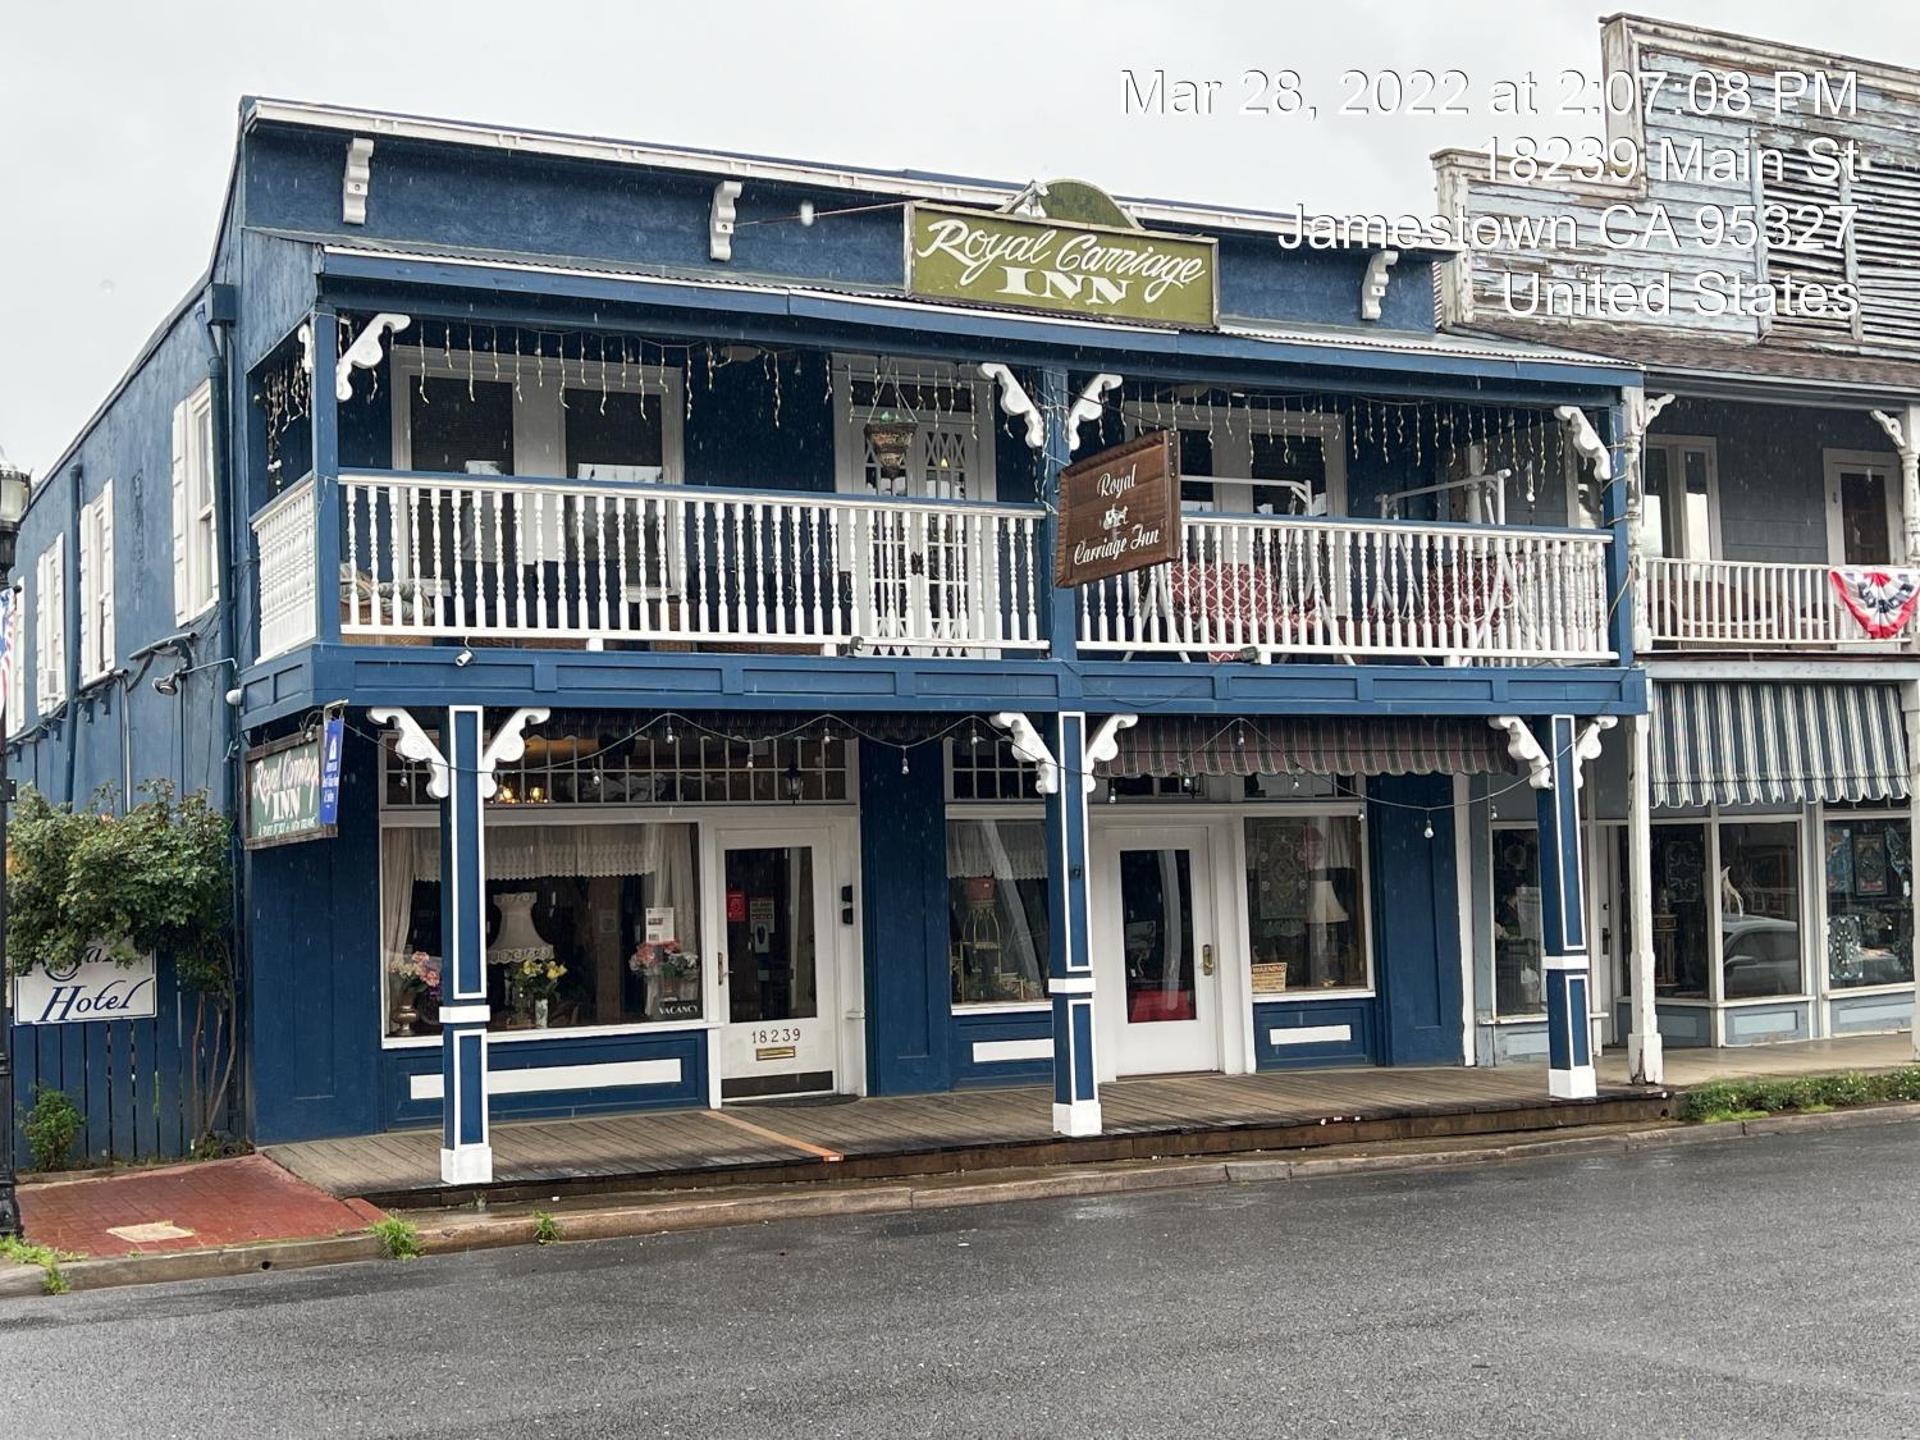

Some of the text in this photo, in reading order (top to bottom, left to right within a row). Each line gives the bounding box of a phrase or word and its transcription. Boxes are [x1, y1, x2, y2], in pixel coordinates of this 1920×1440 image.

[916, 219, 1207, 303] Royal Carriage
[996, 266, 1135, 305] INN
[1097, 463, 1138, 499] Royal
[1074, 524, 1161, 565] Carriage Inn
[252, 757, 284, 816] Royal
[272, 786, 302, 821] INN
[36, 977, 153, 1022] Hotel
[659, 1004, 698, 1015] VACANCY
[752, 1027, 801, 1044] 18239
